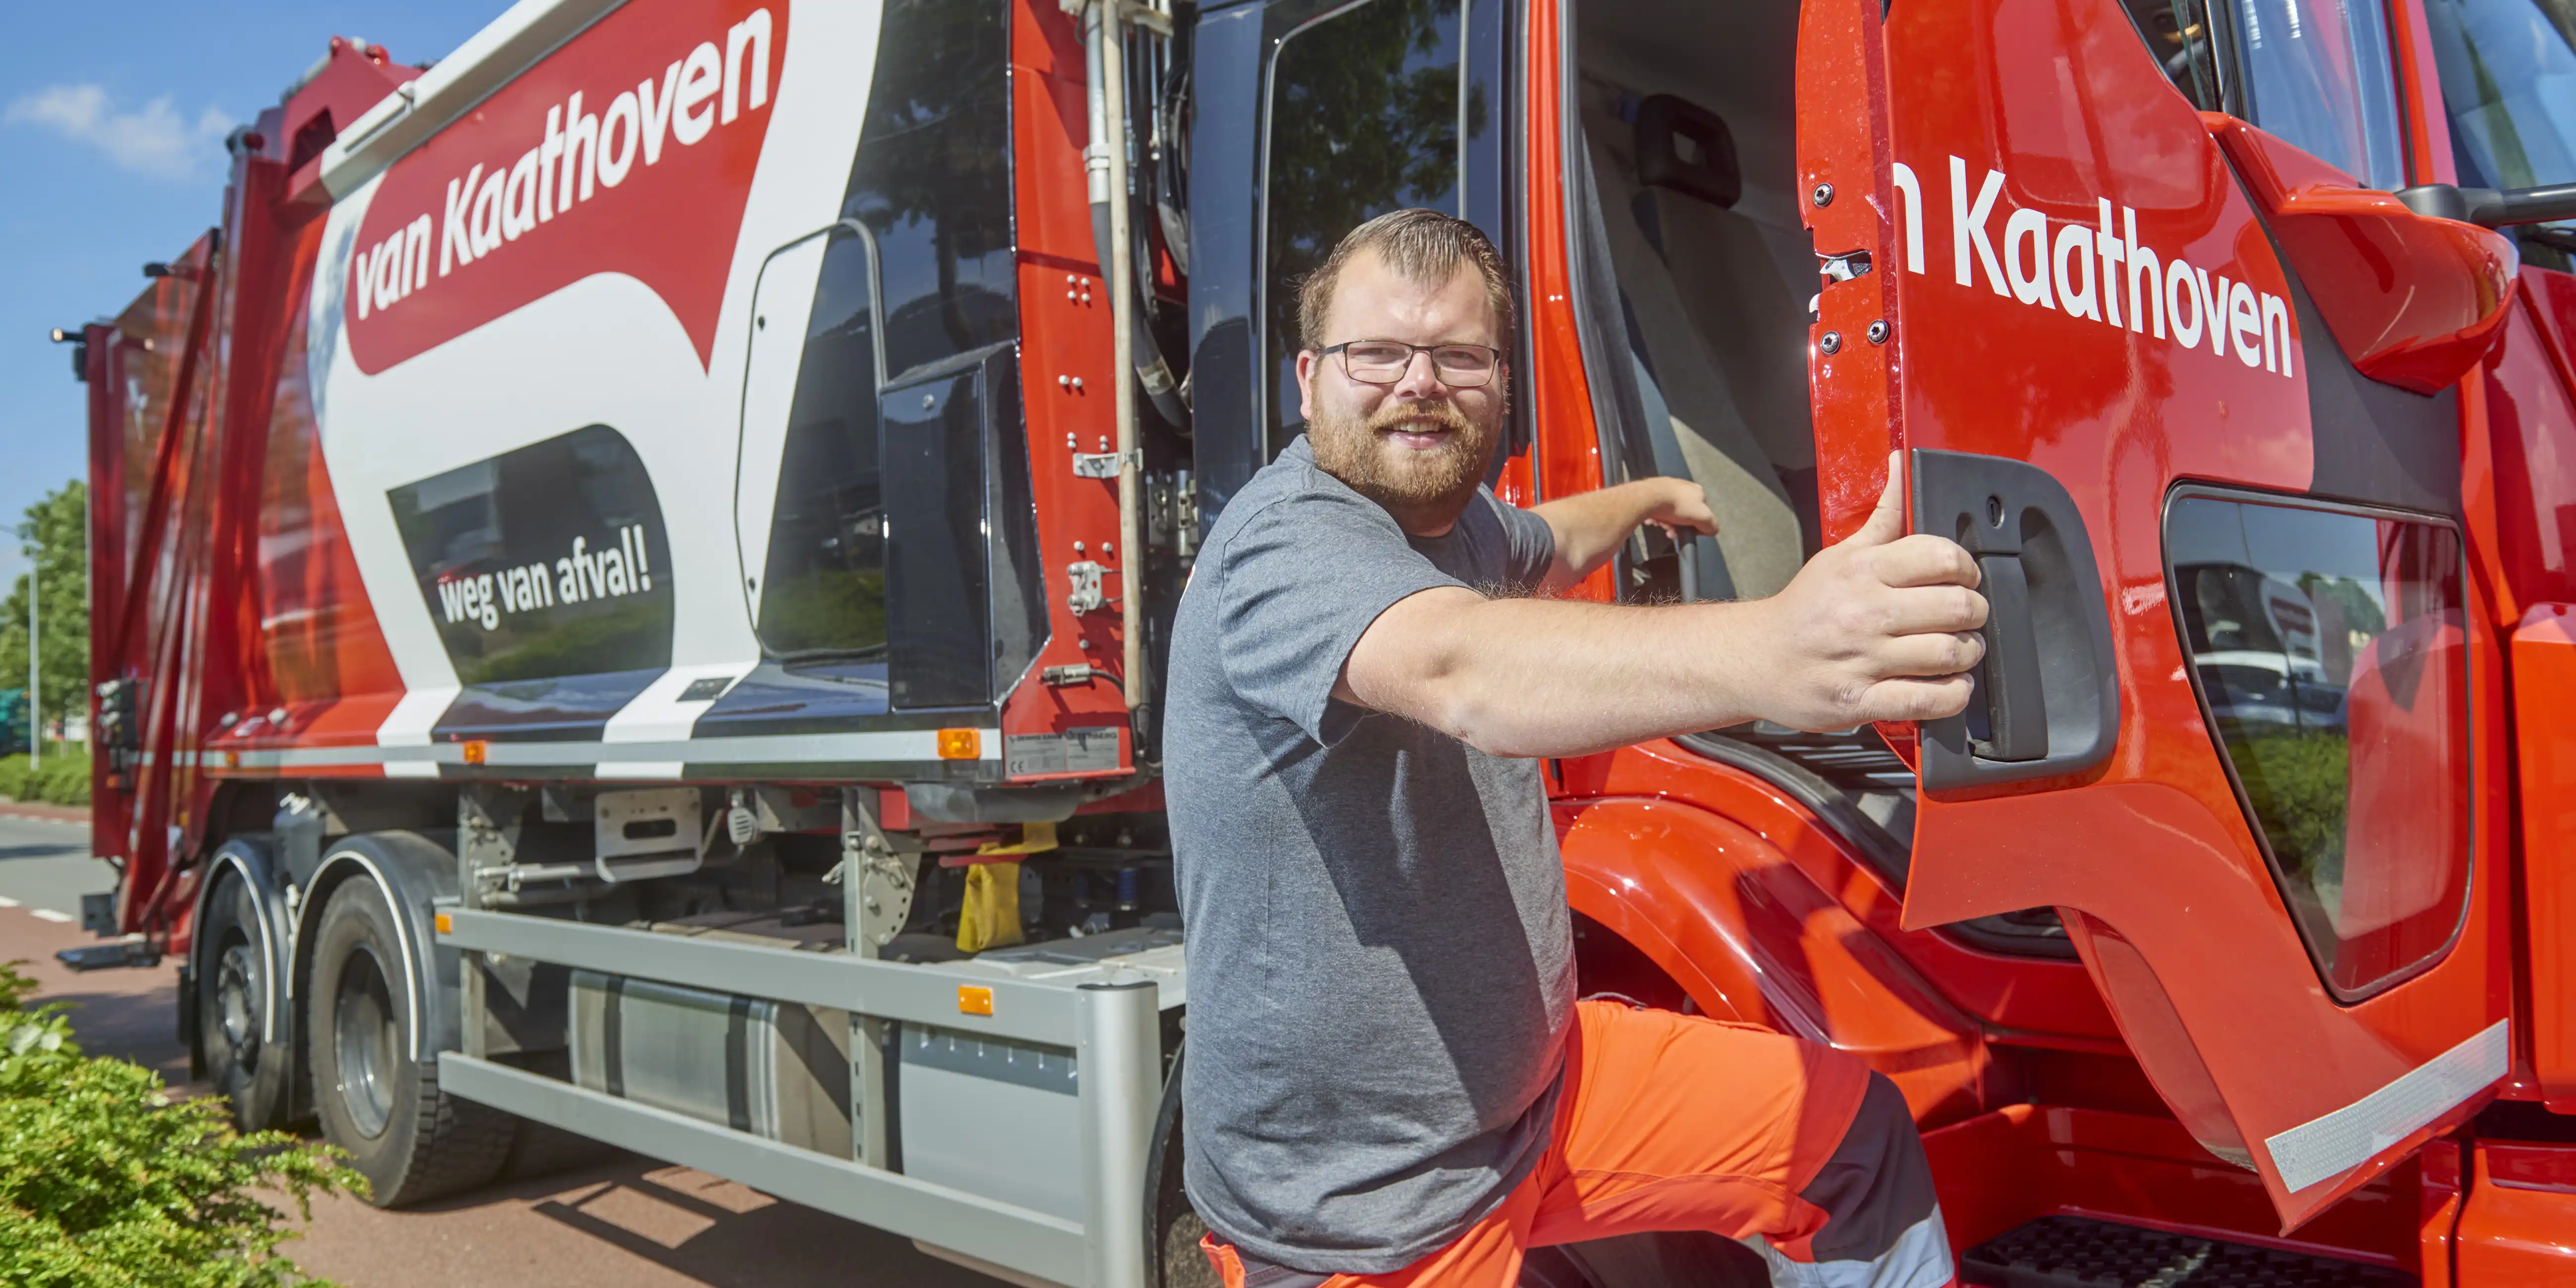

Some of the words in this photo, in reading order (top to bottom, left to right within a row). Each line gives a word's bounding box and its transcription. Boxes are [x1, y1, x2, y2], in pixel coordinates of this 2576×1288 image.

[355, 214, 432, 320] van
[439, 7, 771, 277] Kaathoven
[1949, 155, 2292, 378] Kaathoven
[438, 574, 500, 630] weg
[497, 561, 554, 613] van
[556, 524, 651, 604] afval!
